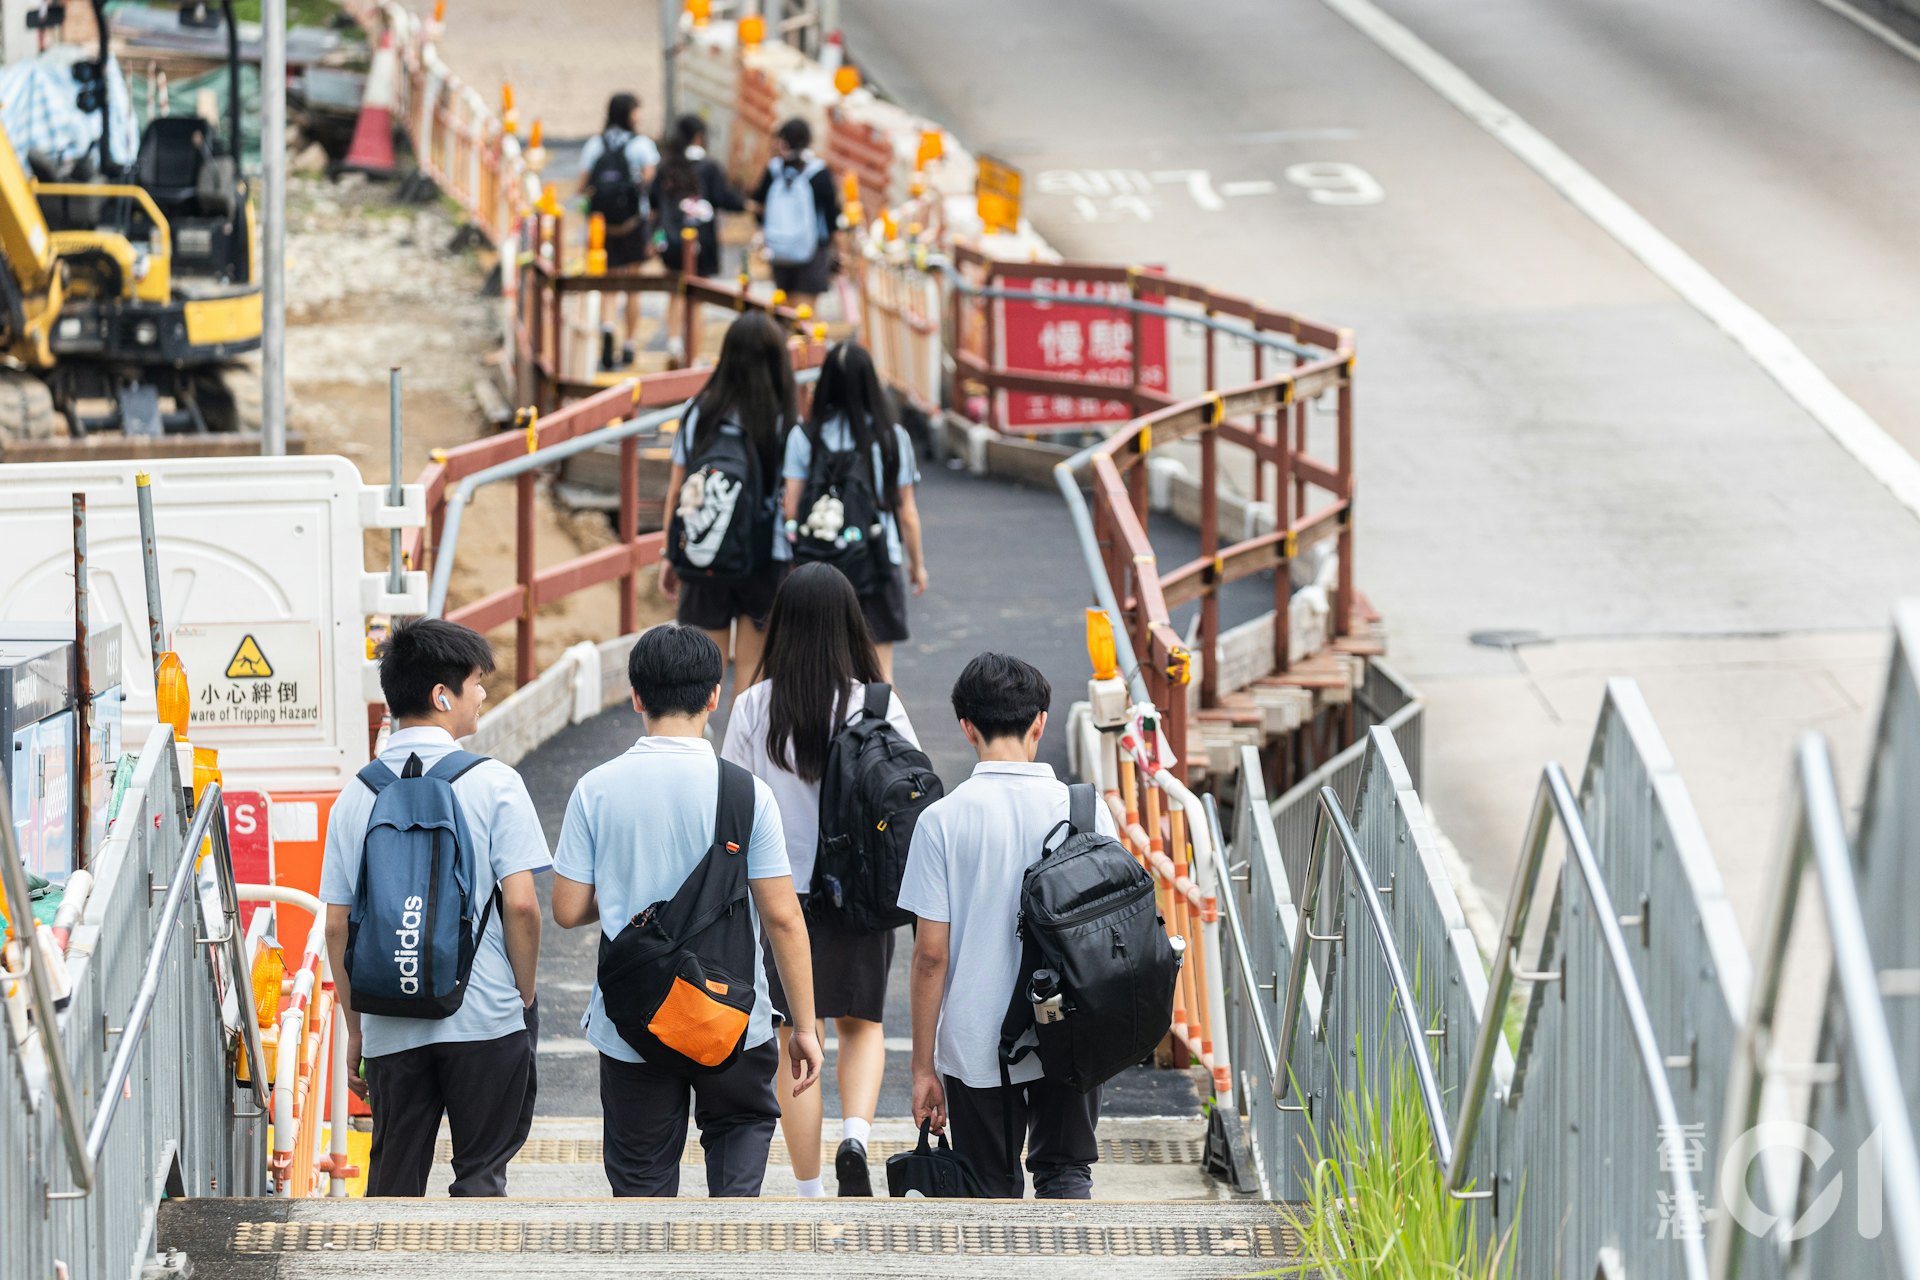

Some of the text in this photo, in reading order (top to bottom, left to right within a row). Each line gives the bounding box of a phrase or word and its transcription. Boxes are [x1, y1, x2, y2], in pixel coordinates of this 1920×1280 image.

[1038, 318, 1134, 367] 慢駛
[200, 681, 298, 705] 小心絆倒
[190, 704, 318, 723] ware of Tripping Hazard
[394, 895, 423, 995] adidas
